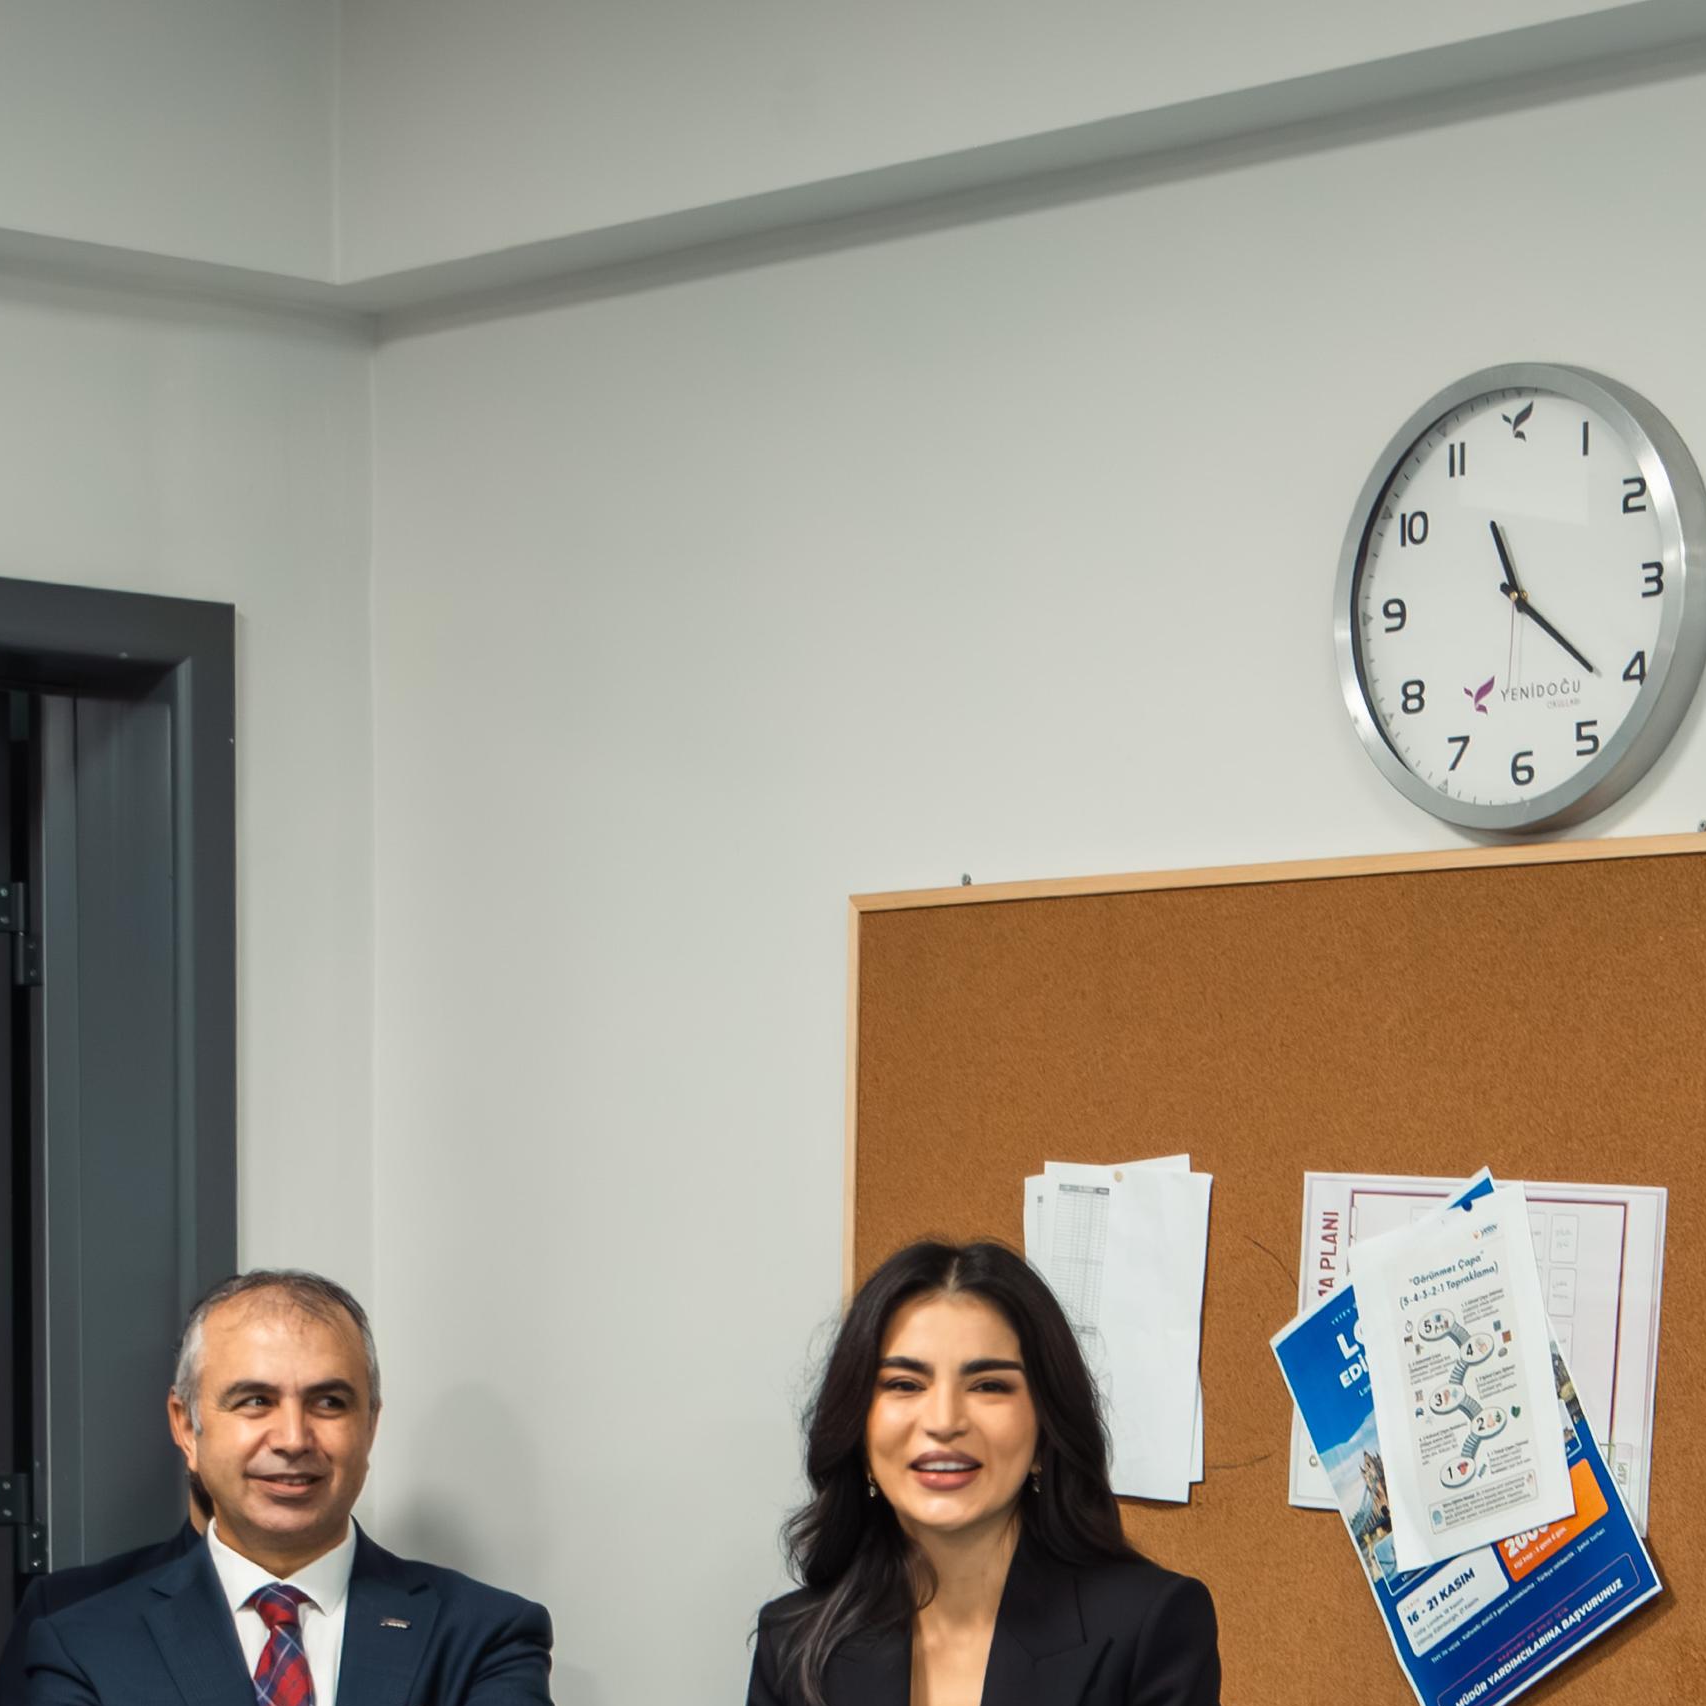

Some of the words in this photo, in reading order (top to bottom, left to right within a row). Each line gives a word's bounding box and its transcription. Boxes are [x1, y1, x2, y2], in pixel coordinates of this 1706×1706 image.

[1582, 420, 1590, 456] 1
[1449, 441, 1466, 477] 11
[1622, 476, 1648, 514] 2
[1400, 511, 1429, 547] 10
[1641, 562, 1664, 598] 3
[1382, 598, 1407, 633] 9
[1622, 650, 1647, 687] 4
[1401, 679, 1426, 715] 8
[1447, 735, 1471, 771] 7
[1575, 719, 1601, 757] 5
[1510, 751, 1535, 786] 6
[1319, 1211, 1340, 1271] PLANI
[1424, 1319, 1432, 1334] 5
[1466, 1343, 1474, 1356] 4
[1434, 1393, 1443, 1407] 3
[1476, 1417, 1486, 1432] 2
[1447, 1466, 1454, 1480] 1
[1406, 1611, 1420, 1626] 16
[1426, 1595, 1439, 1611] 21
[1438, 1568, 1476, 1602] KASIM
[1487, 1626, 1562, 1686] YARDIMCILARINA
[1561, 1578, 1624, 1629] BAŞVURUNUZ
